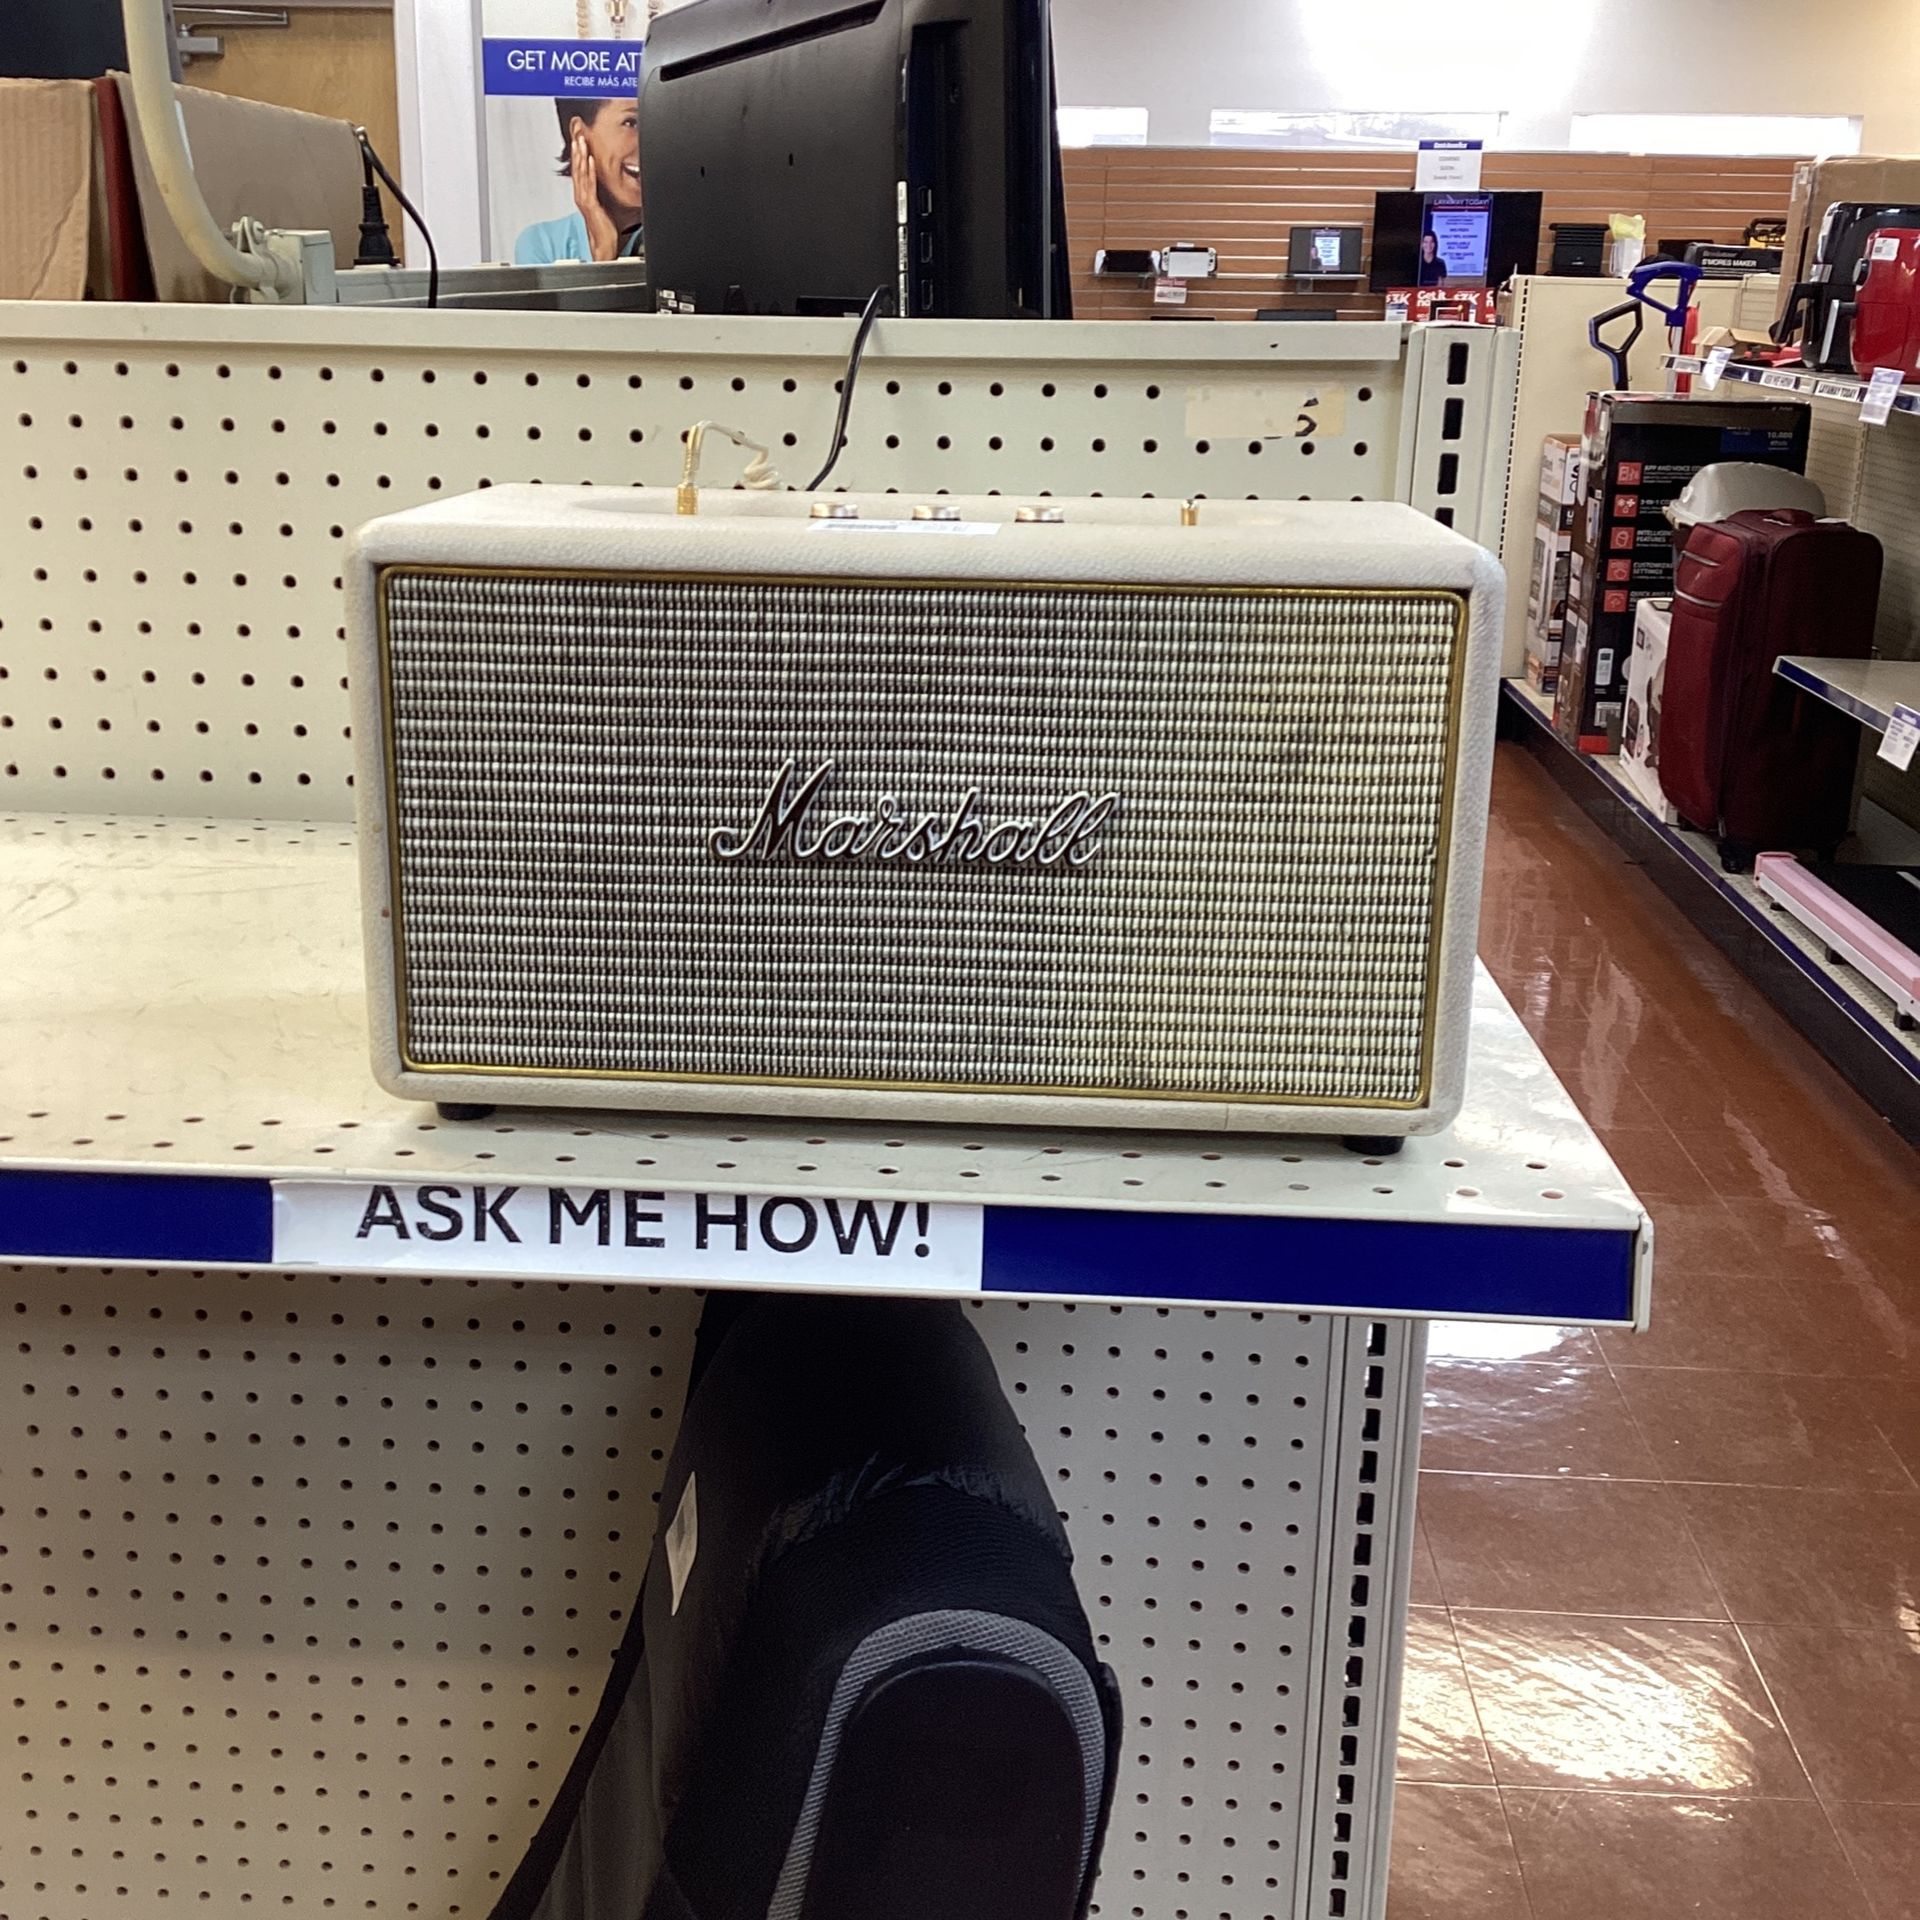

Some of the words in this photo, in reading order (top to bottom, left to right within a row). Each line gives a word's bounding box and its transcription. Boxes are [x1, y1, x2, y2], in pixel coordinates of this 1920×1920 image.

[507, 49, 546, 70] GET
[550, 50, 611, 71] MORE
[564, 76, 595, 87] RECIBE
[597, 74, 620, 88] MÁS
[1732, 259, 1758, 268] MAKER
[709, 758, 1120, 866] Marshall
[355, 1184, 522, 1244] ASK
[548, 1187, 665, 1248] ME
[694, 1192, 931, 1258] HOW!
